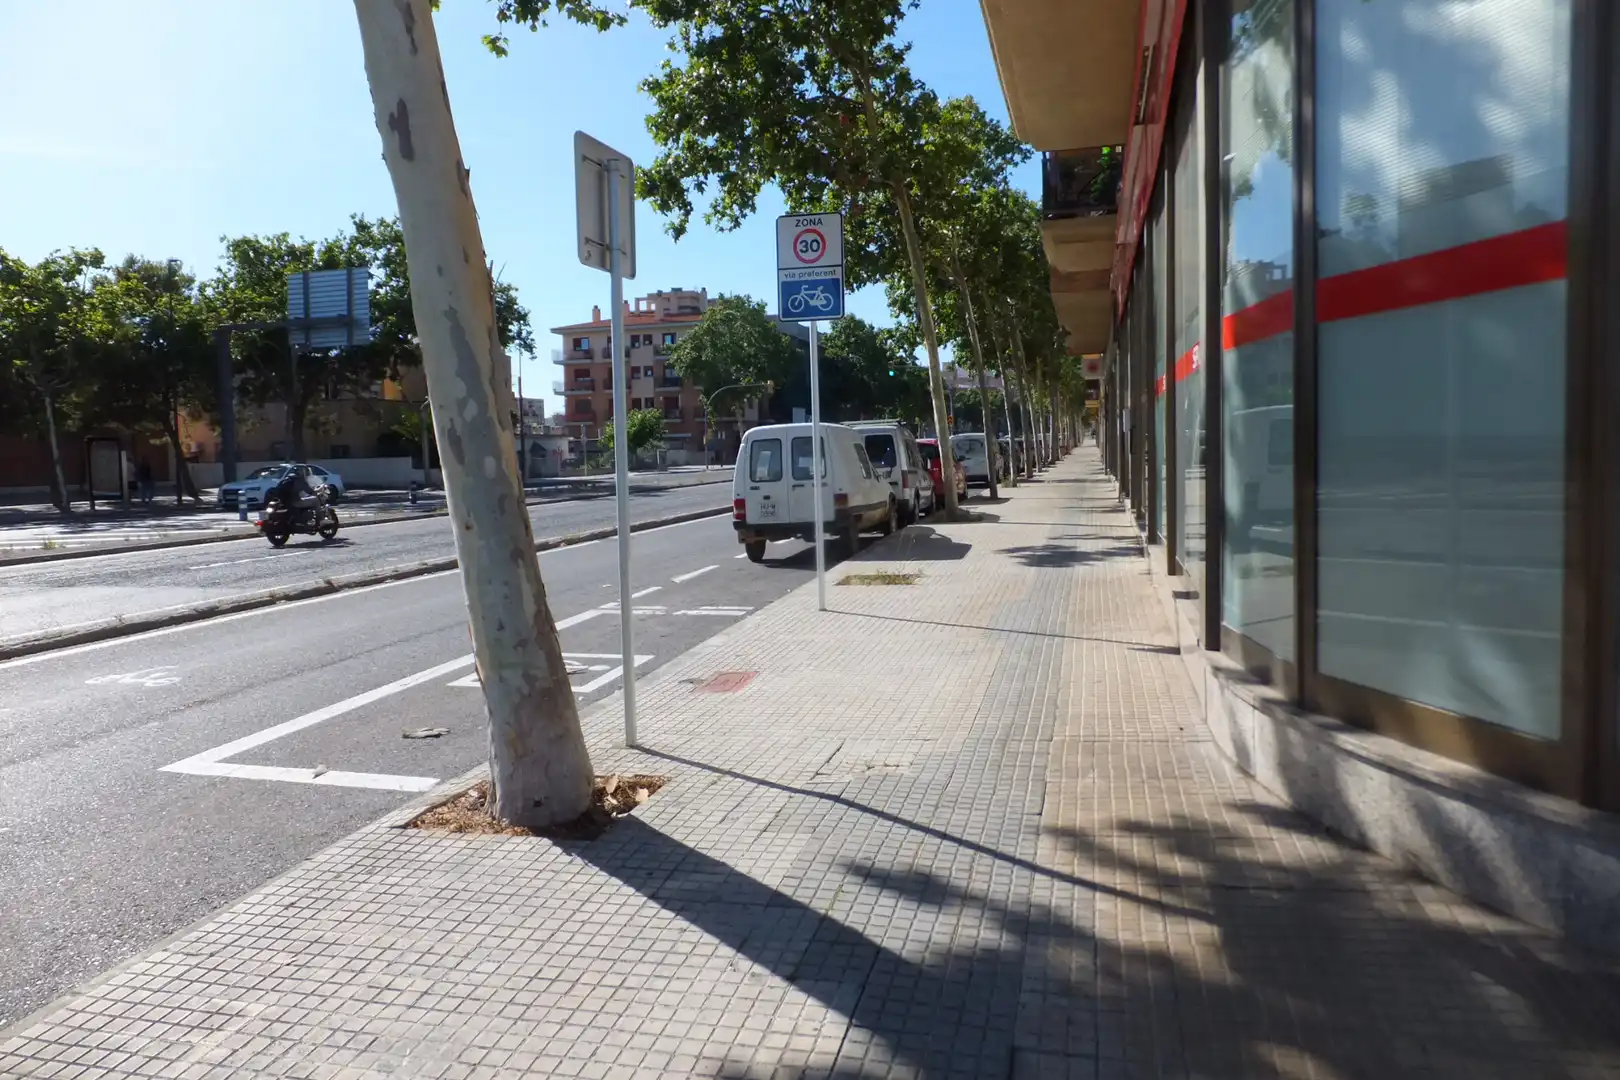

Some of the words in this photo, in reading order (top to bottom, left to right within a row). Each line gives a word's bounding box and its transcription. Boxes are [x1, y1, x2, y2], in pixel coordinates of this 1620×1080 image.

[795, 218, 823, 228] ZONA
[799, 238, 821, 254] 30
[798, 269, 837, 281] preferent
